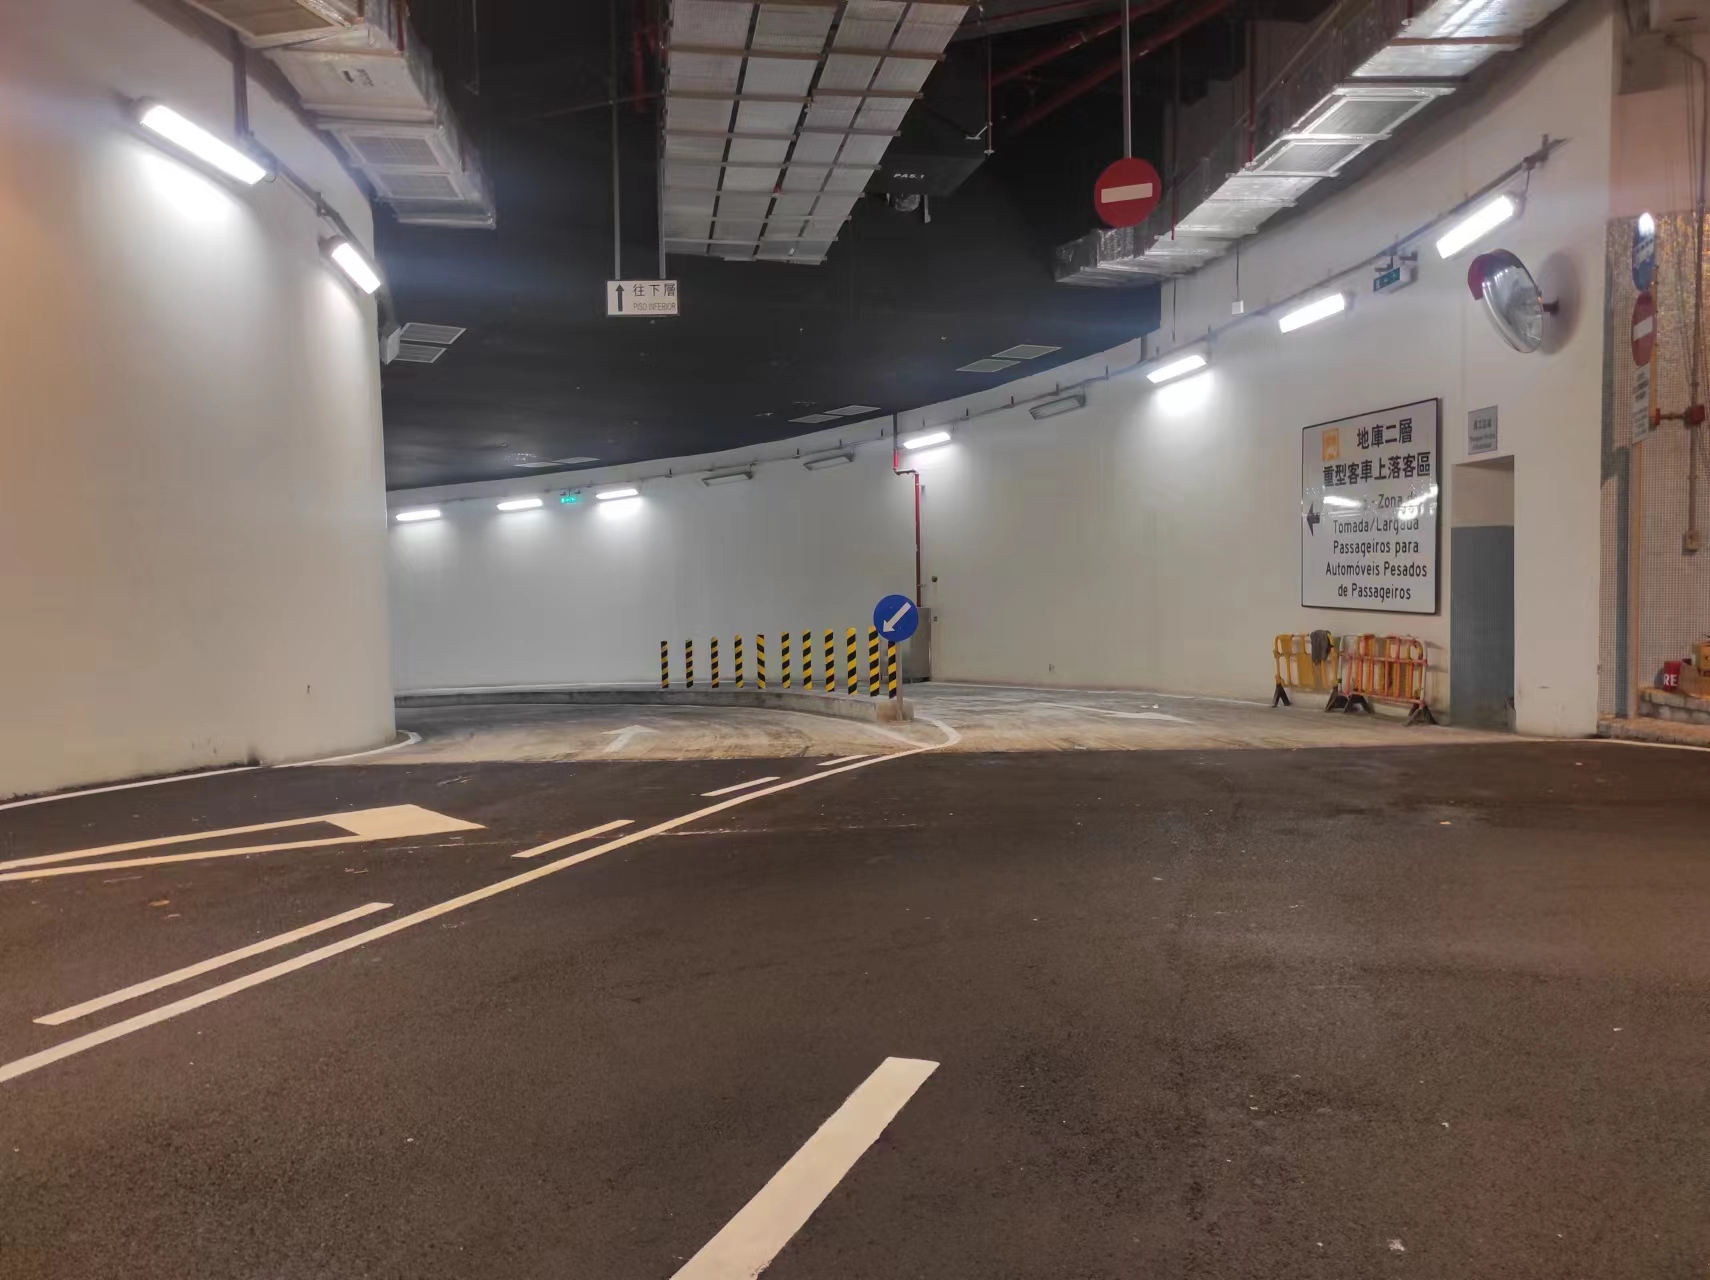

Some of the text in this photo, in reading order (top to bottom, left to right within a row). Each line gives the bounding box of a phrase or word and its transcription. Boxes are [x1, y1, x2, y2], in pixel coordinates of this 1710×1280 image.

[633, 283, 676, 296] 往下層
[633, 302, 676, 311] PISO INFERIOR
[1357, 417, 1413, 450] 地庫二層
[1323, 451, 1431, 488] 重型客車上落客區
[1378, 493, 1404, 509] Zona
[1333, 538, 1419, 558] Passageiros para
[1325, 560, 1428, 578] Automóveis Pesados
[1337, 582, 1412, 603] de Passageiros
